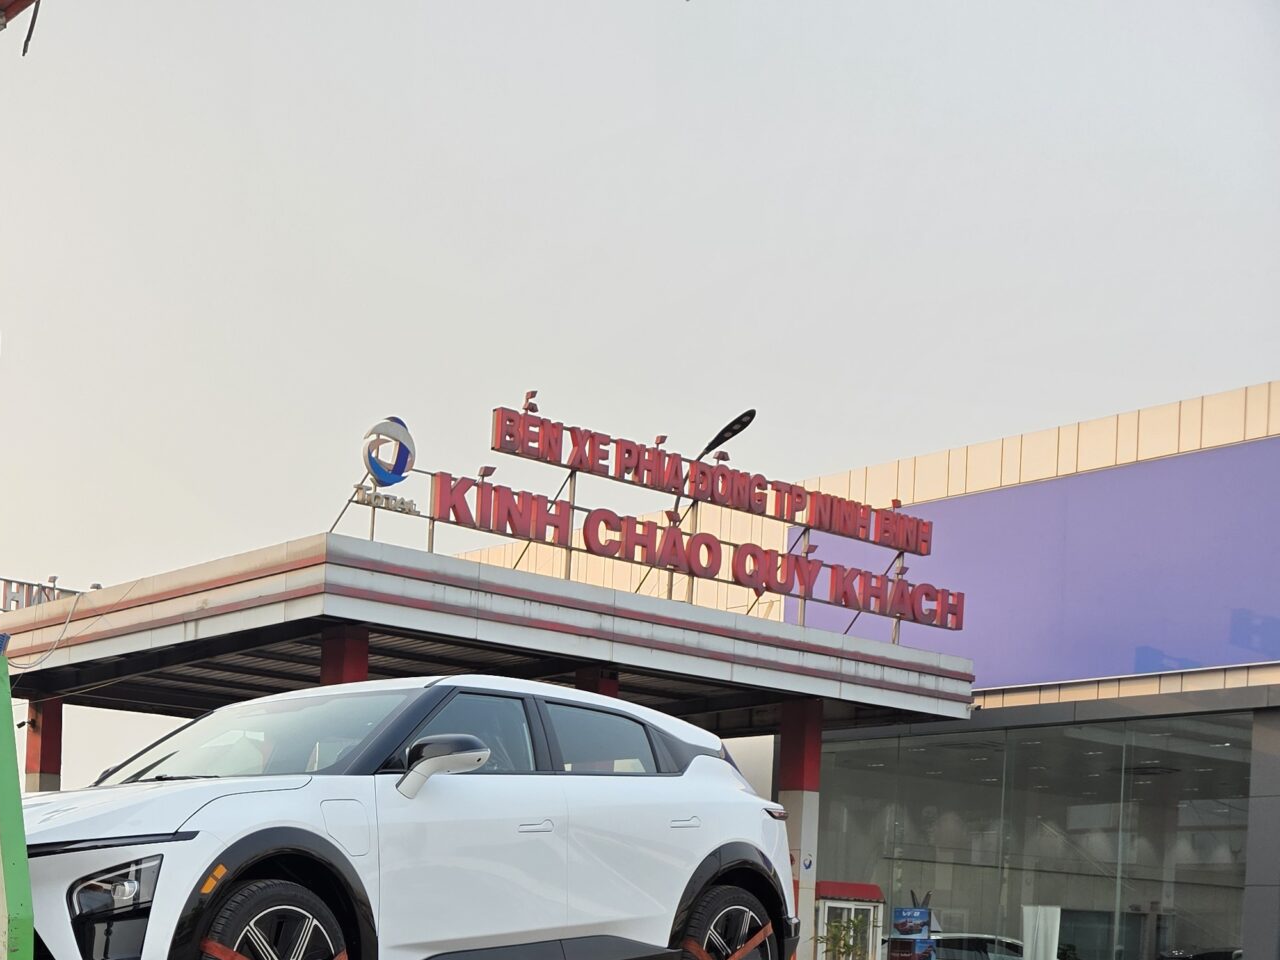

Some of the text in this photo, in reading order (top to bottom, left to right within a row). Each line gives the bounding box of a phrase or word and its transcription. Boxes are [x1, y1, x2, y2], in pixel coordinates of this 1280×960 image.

[433, 466, 965, 631] KÍNH CHÀO QUÝ KHÁCH
[492, 390, 933, 556] BẾN XE PHÍA ĐÔNG TP NINH BÌNH
